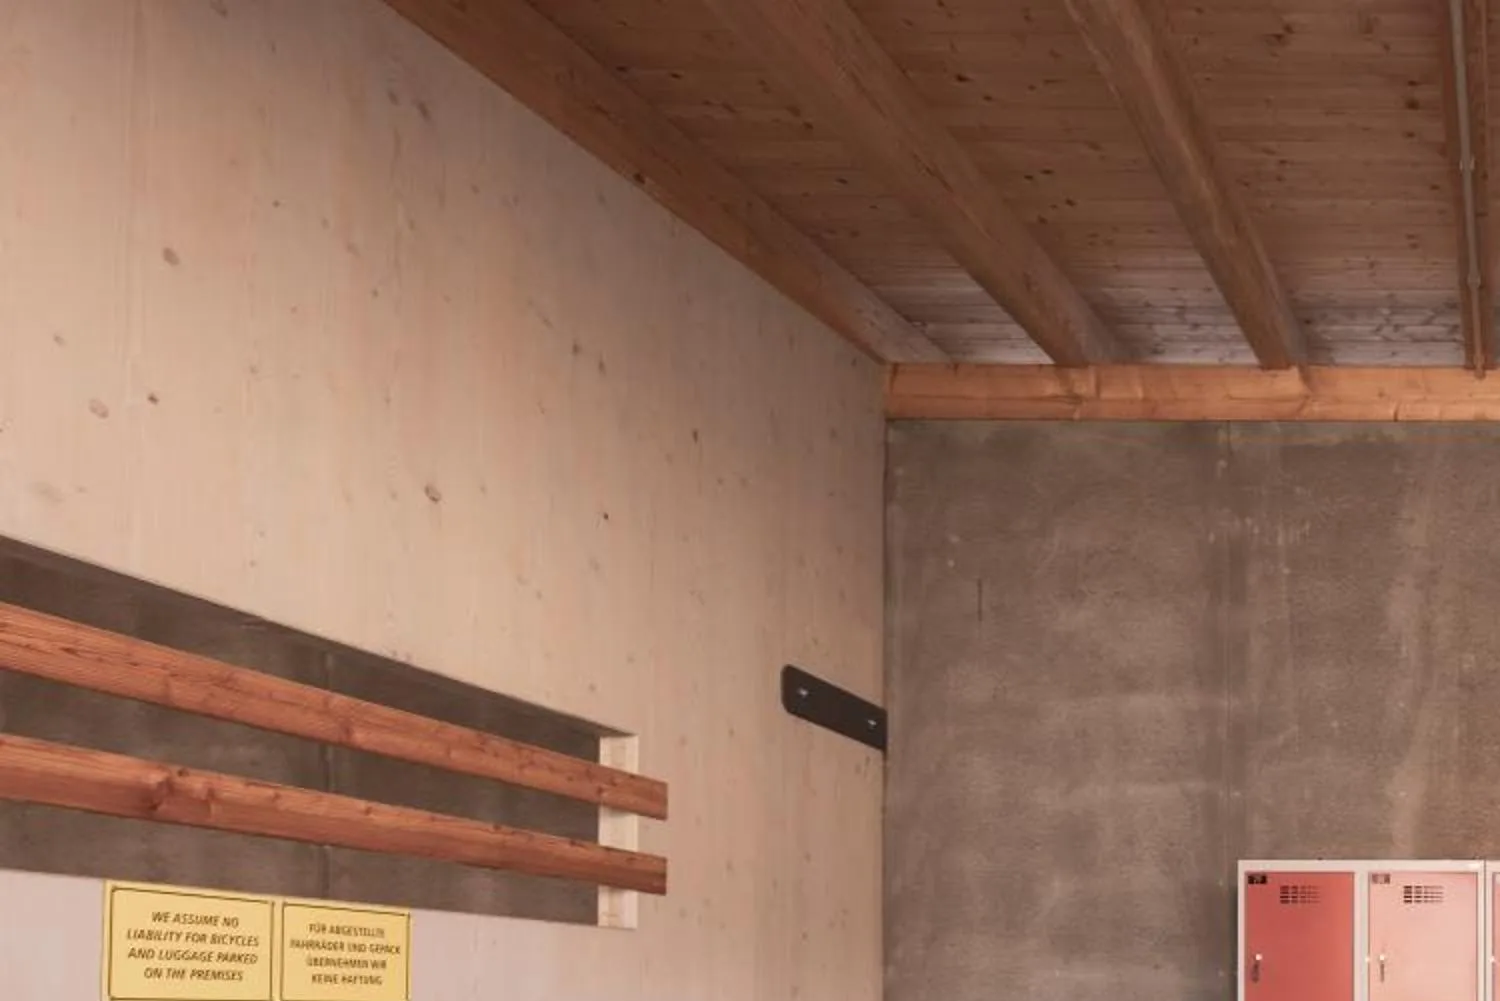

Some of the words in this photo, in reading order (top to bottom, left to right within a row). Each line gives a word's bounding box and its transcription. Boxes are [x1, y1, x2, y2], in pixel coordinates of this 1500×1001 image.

[151, 911, 170, 923] WE
[172, 913, 220, 926] ASSUME
[222, 916, 239, 928] NO
[127, 928, 182, 942] LIABILITY
[185, 931, 207, 943] FOR
[209, 933, 259, 947] BICYCLES
[127, 947, 155, 959] AND
[158, 949, 214, 962] LUGGAGE
[216, 951, 258, 965] PARKED
[143, 967, 162, 979] ON
[165, 967, 186, 980] THE
[189, 968, 243, 981] PREMISES
